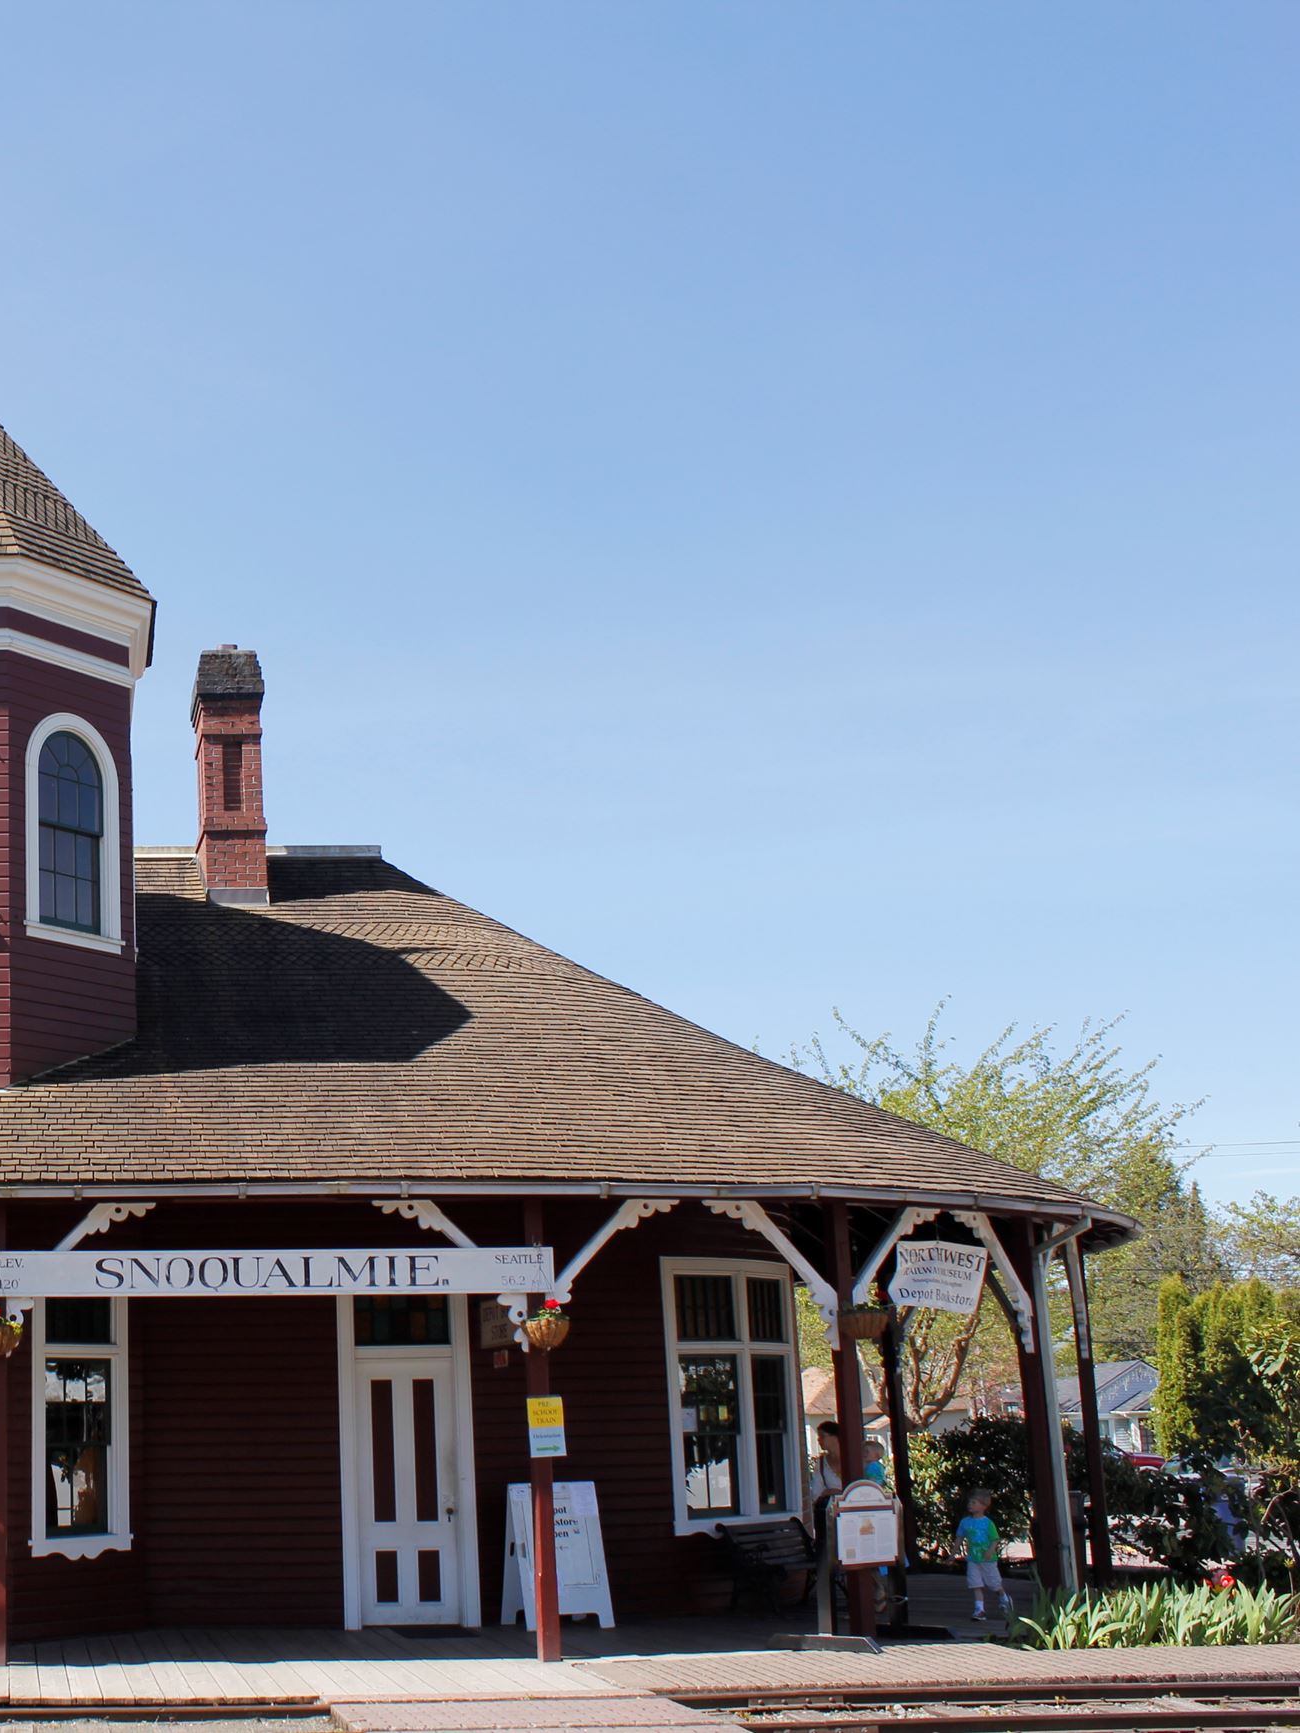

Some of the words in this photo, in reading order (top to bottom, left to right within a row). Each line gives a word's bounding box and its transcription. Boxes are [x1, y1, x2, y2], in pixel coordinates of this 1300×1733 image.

[495, 1253, 544, 1264] SEATTLE
[899, 1247, 985, 1272] NORTHWEST
[501, 1275, 526, 1286] 56.2
[899, 1287, 933, 1303] Depot
